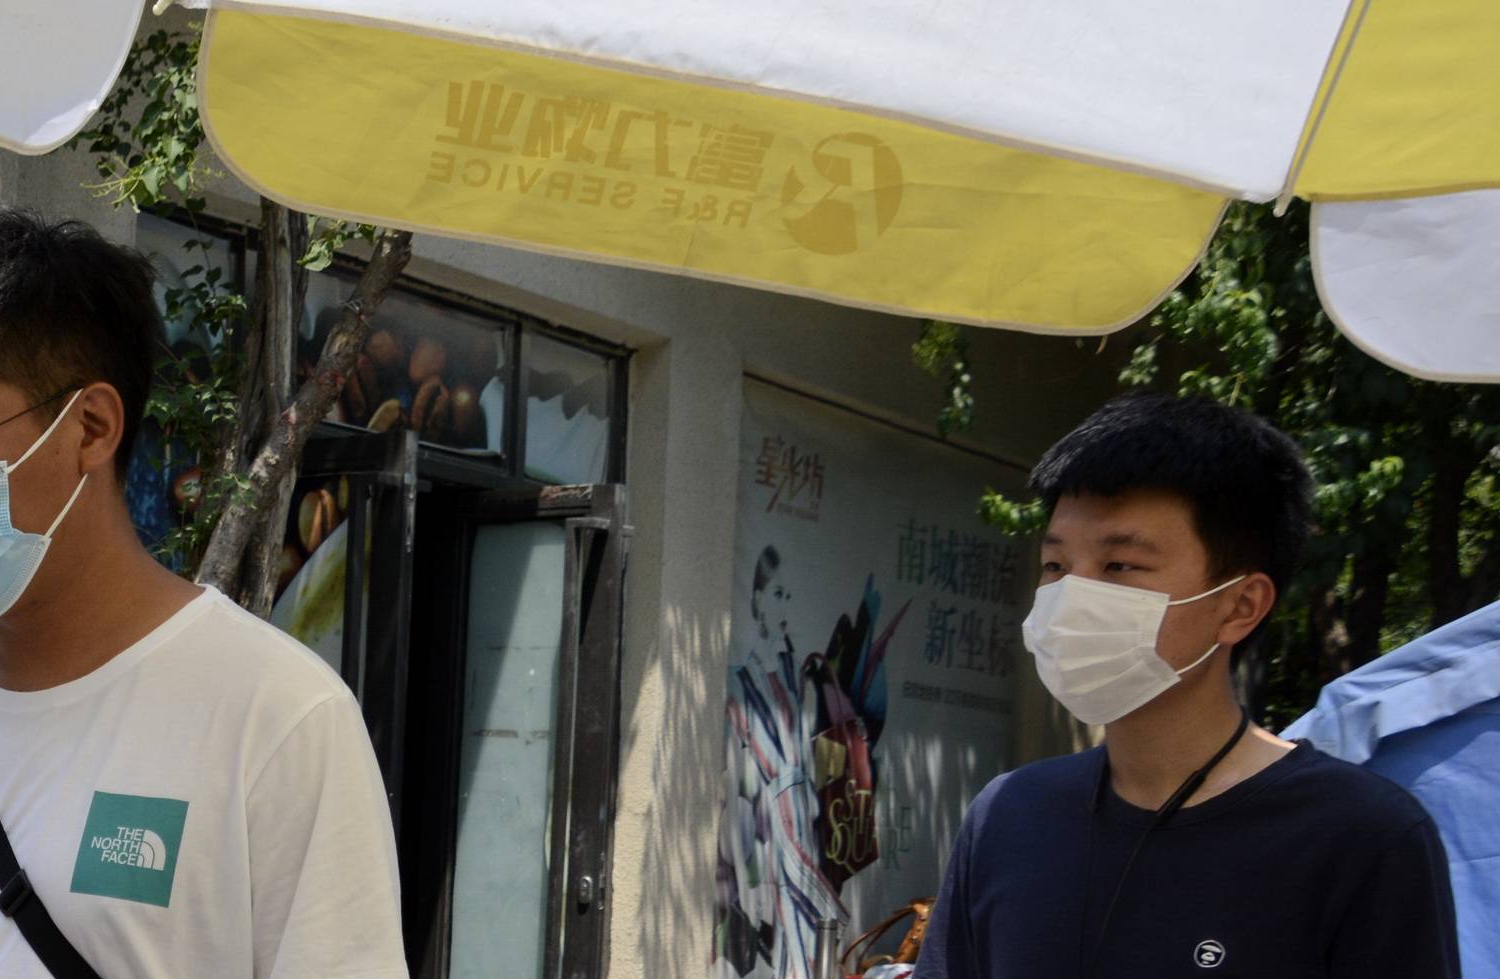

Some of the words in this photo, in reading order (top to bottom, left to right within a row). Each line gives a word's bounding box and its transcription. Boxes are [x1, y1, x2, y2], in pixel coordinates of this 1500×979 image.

[117, 826, 144, 841] THE
[90, 836, 142, 854] NORTH
[100, 850, 139, 867] FACE
